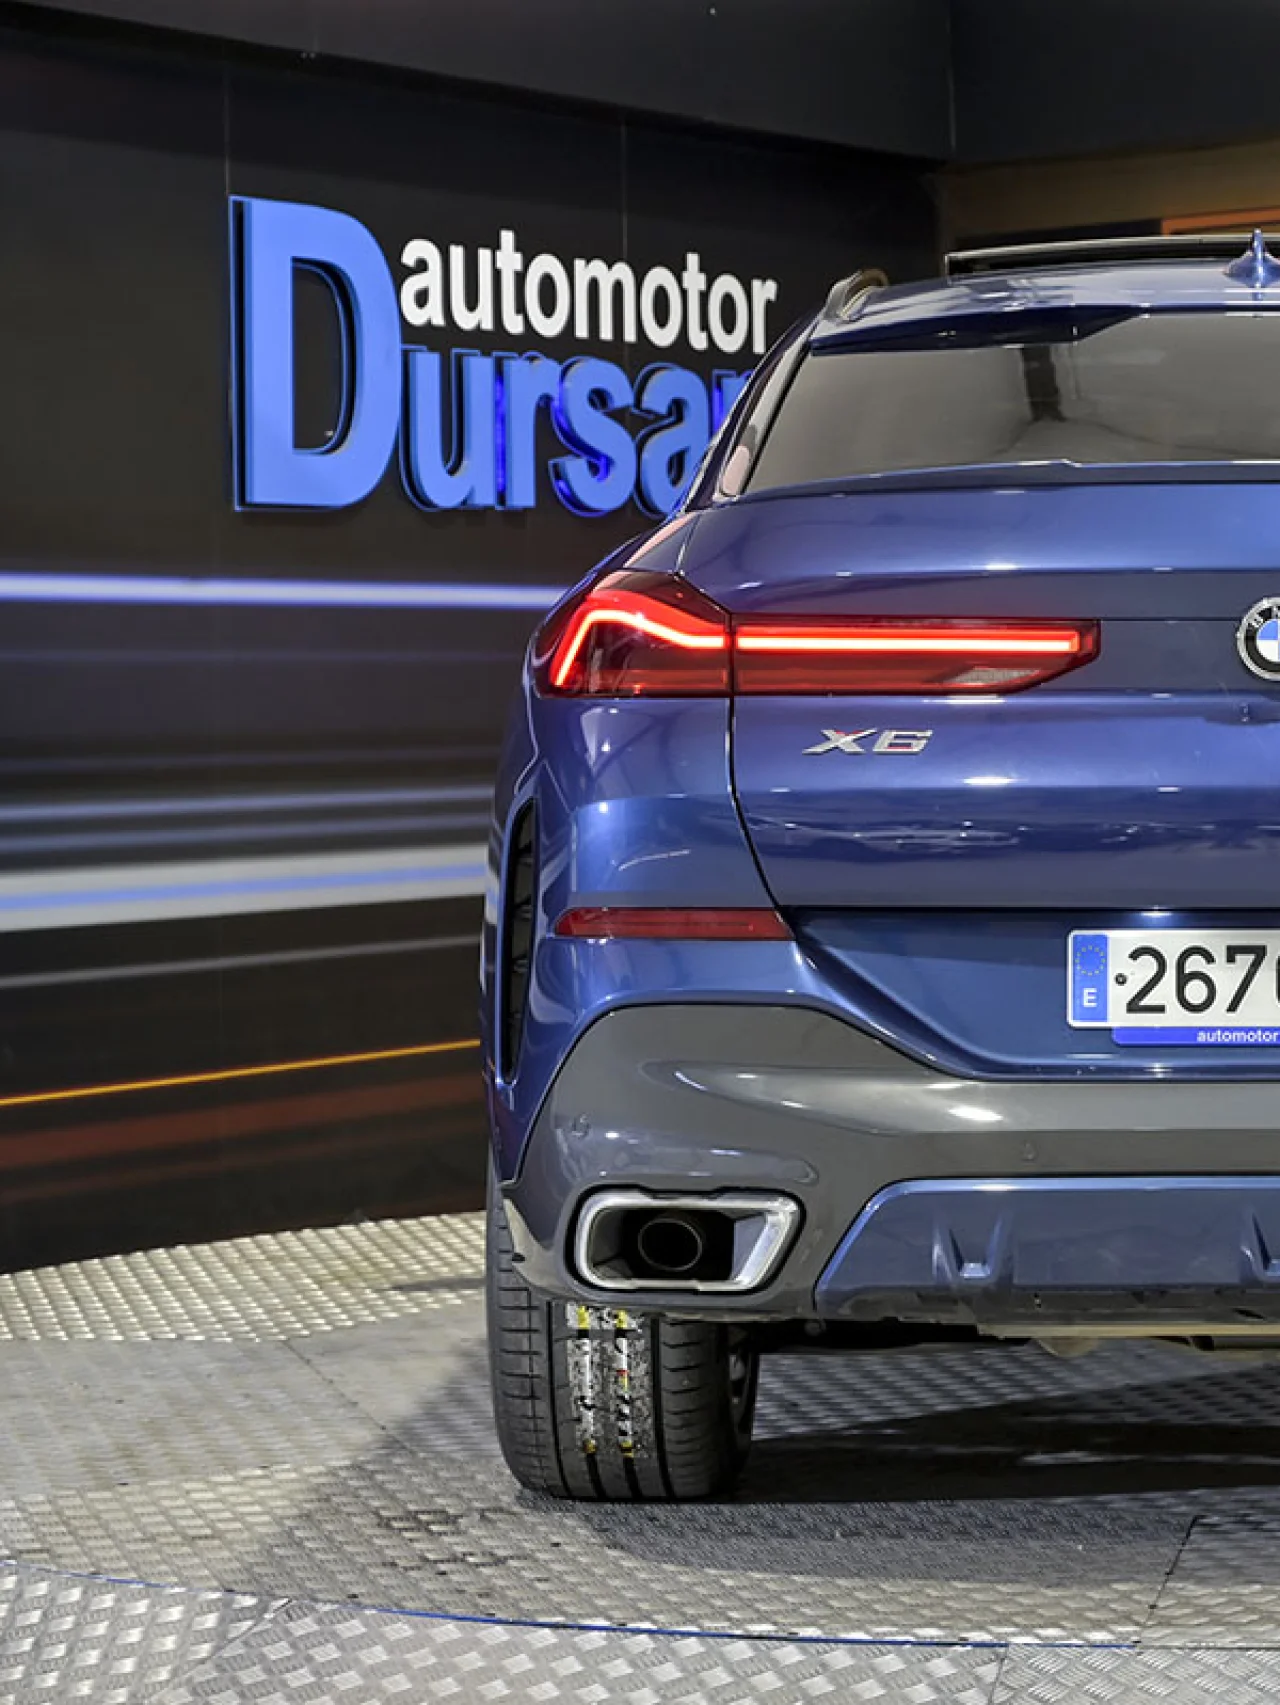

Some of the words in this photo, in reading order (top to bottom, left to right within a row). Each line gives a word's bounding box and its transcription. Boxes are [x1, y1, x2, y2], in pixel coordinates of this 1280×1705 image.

[400, 229, 778, 354] automotor
[802, 729, 933, 756] X6
[1082, 988, 1098, 1008] E
[1196, 1028, 1279, 1042] automotor
